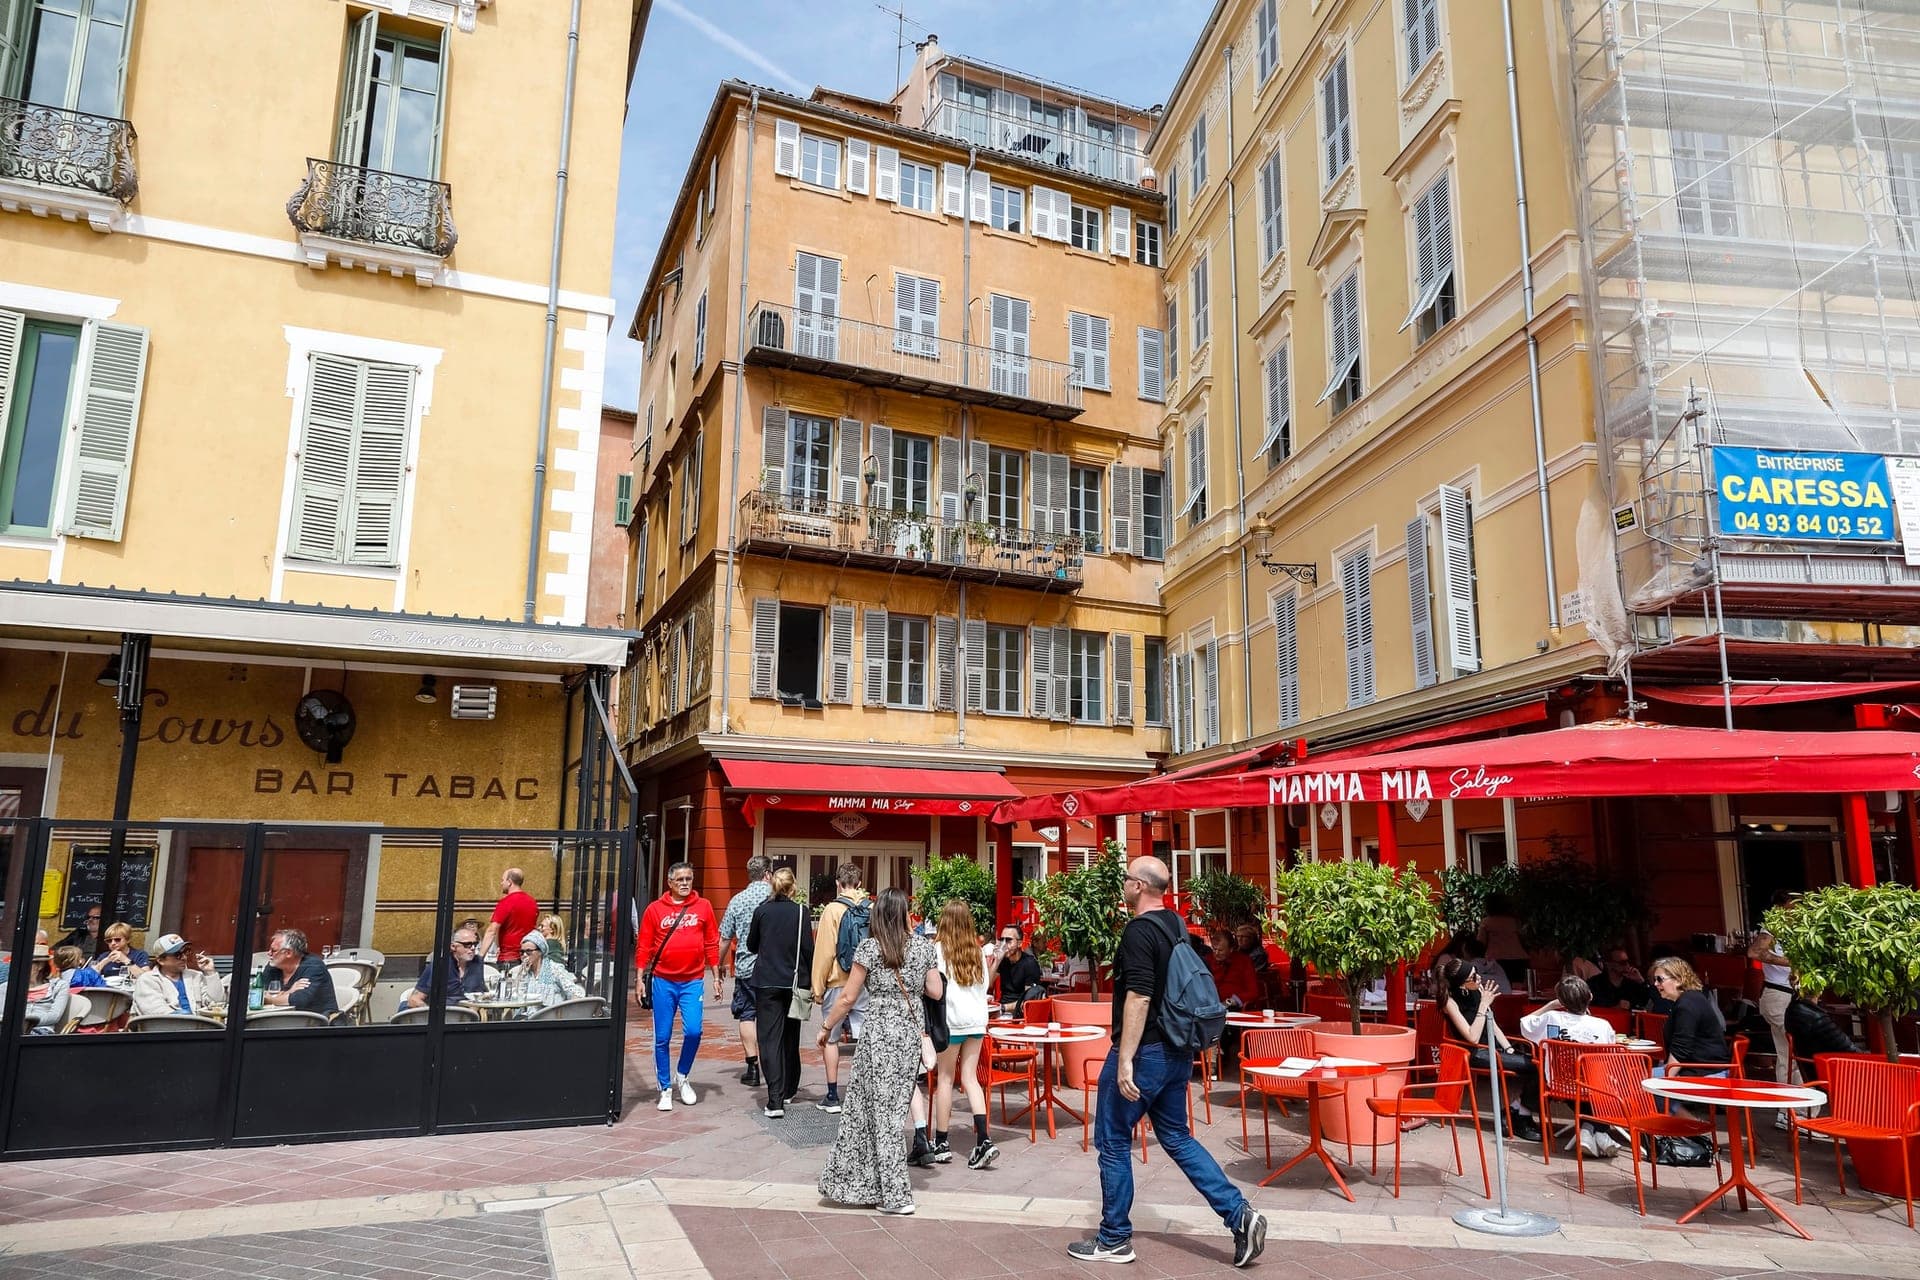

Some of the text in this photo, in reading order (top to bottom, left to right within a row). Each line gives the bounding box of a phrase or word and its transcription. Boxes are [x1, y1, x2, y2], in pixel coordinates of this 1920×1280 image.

[1756, 454, 1845, 472] ENTREPRISE
[1721, 475, 1889, 508] CARESSA
[1734, 511, 1761, 531] 04
[1765, 513, 1791, 532] 93
[1796, 514, 1822, 533] 84
[1827, 516, 1851, 534] 03
[1857, 517, 1884, 535] 52
[12, 684, 84, 740] du
[254, 768, 539, 801] BAR TABAC
[1268, 767, 1514, 805] MAMMA MIA Saleya
[828, 796, 866, 809] MAMMA
[871, 798, 890, 810] MIA
